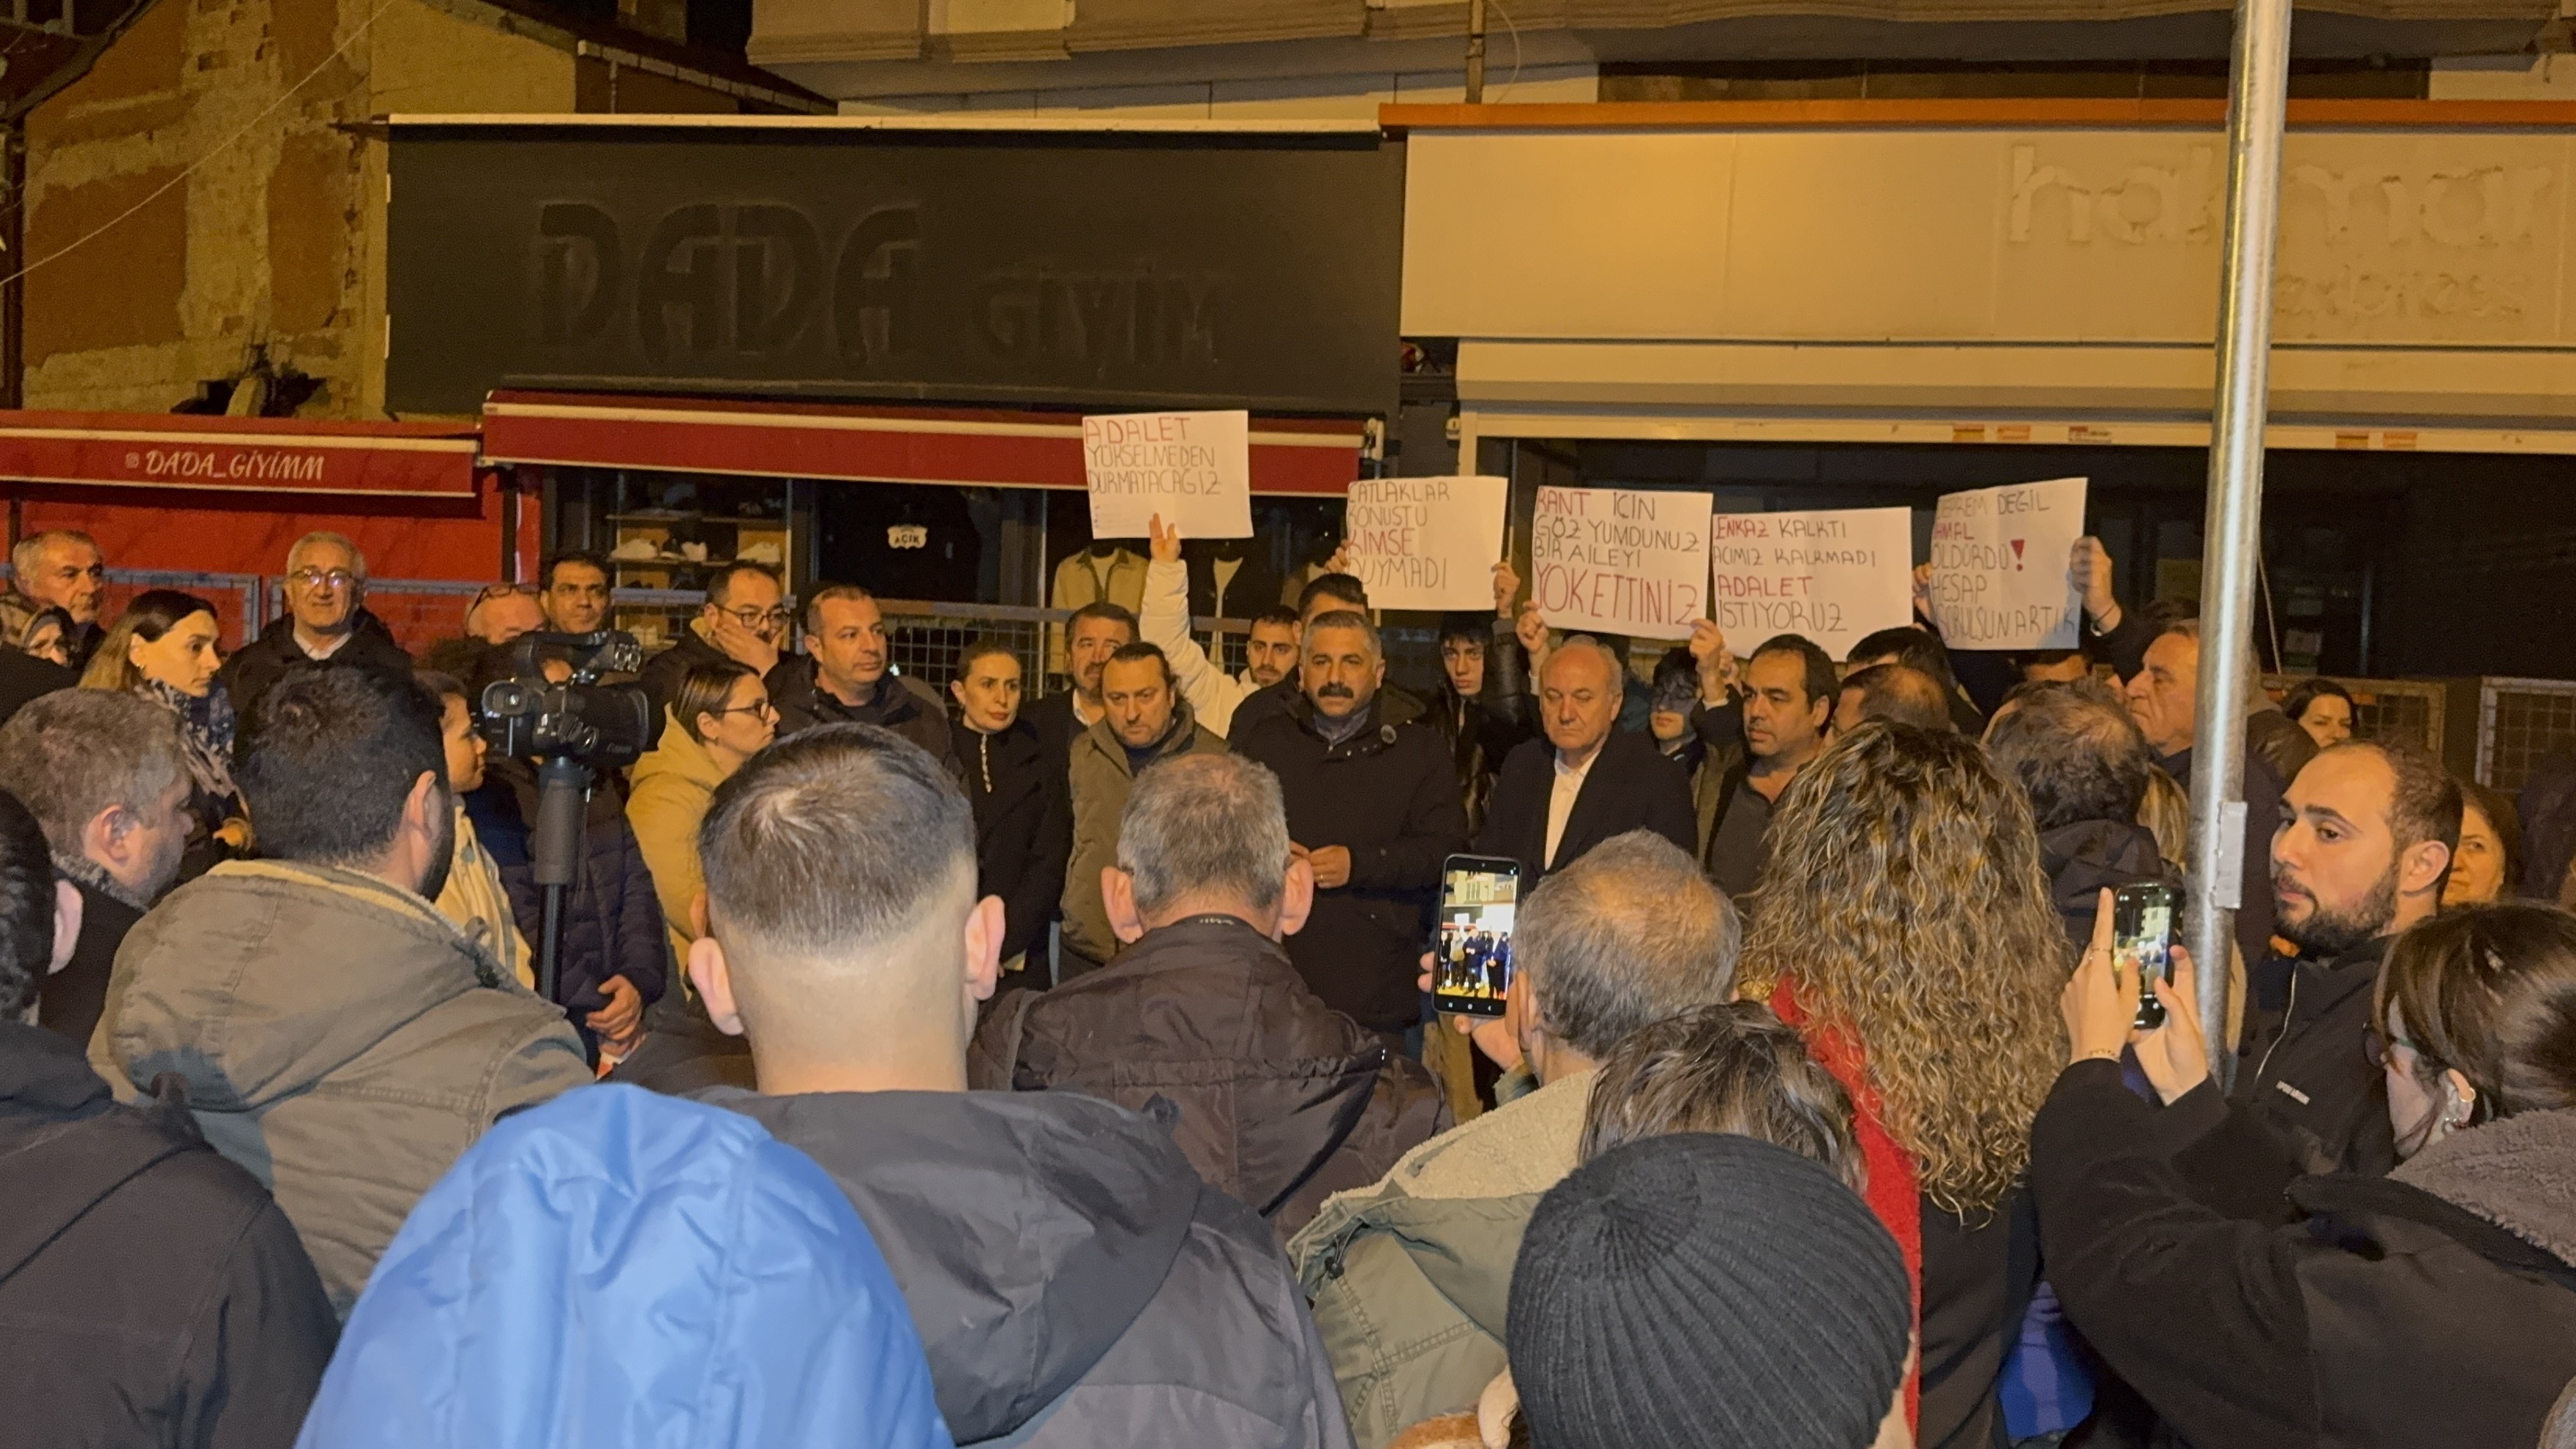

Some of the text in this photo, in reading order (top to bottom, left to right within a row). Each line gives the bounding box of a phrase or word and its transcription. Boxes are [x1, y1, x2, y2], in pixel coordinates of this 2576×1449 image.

[539, 202, 921, 366] DADA
[1085, 416, 1191, 444] ADALET
[1087, 443, 1215, 468] YÜKSELMEDEN
[1537, 487, 1591, 517] RANT
[1587, 518, 1700, 553] YUMDUNUZ
[1715, 516, 1846, 540] ENKAZ KALKTI
[1712, 545, 1876, 568] ACIMIZ KALKMADI
[1348, 557, 1447, 591] DUYMADI
[1717, 574, 1813, 598] ADALET
[1931, 573, 1988, 604] HESAP
[2015, 604, 2077, 638] ARTIK
